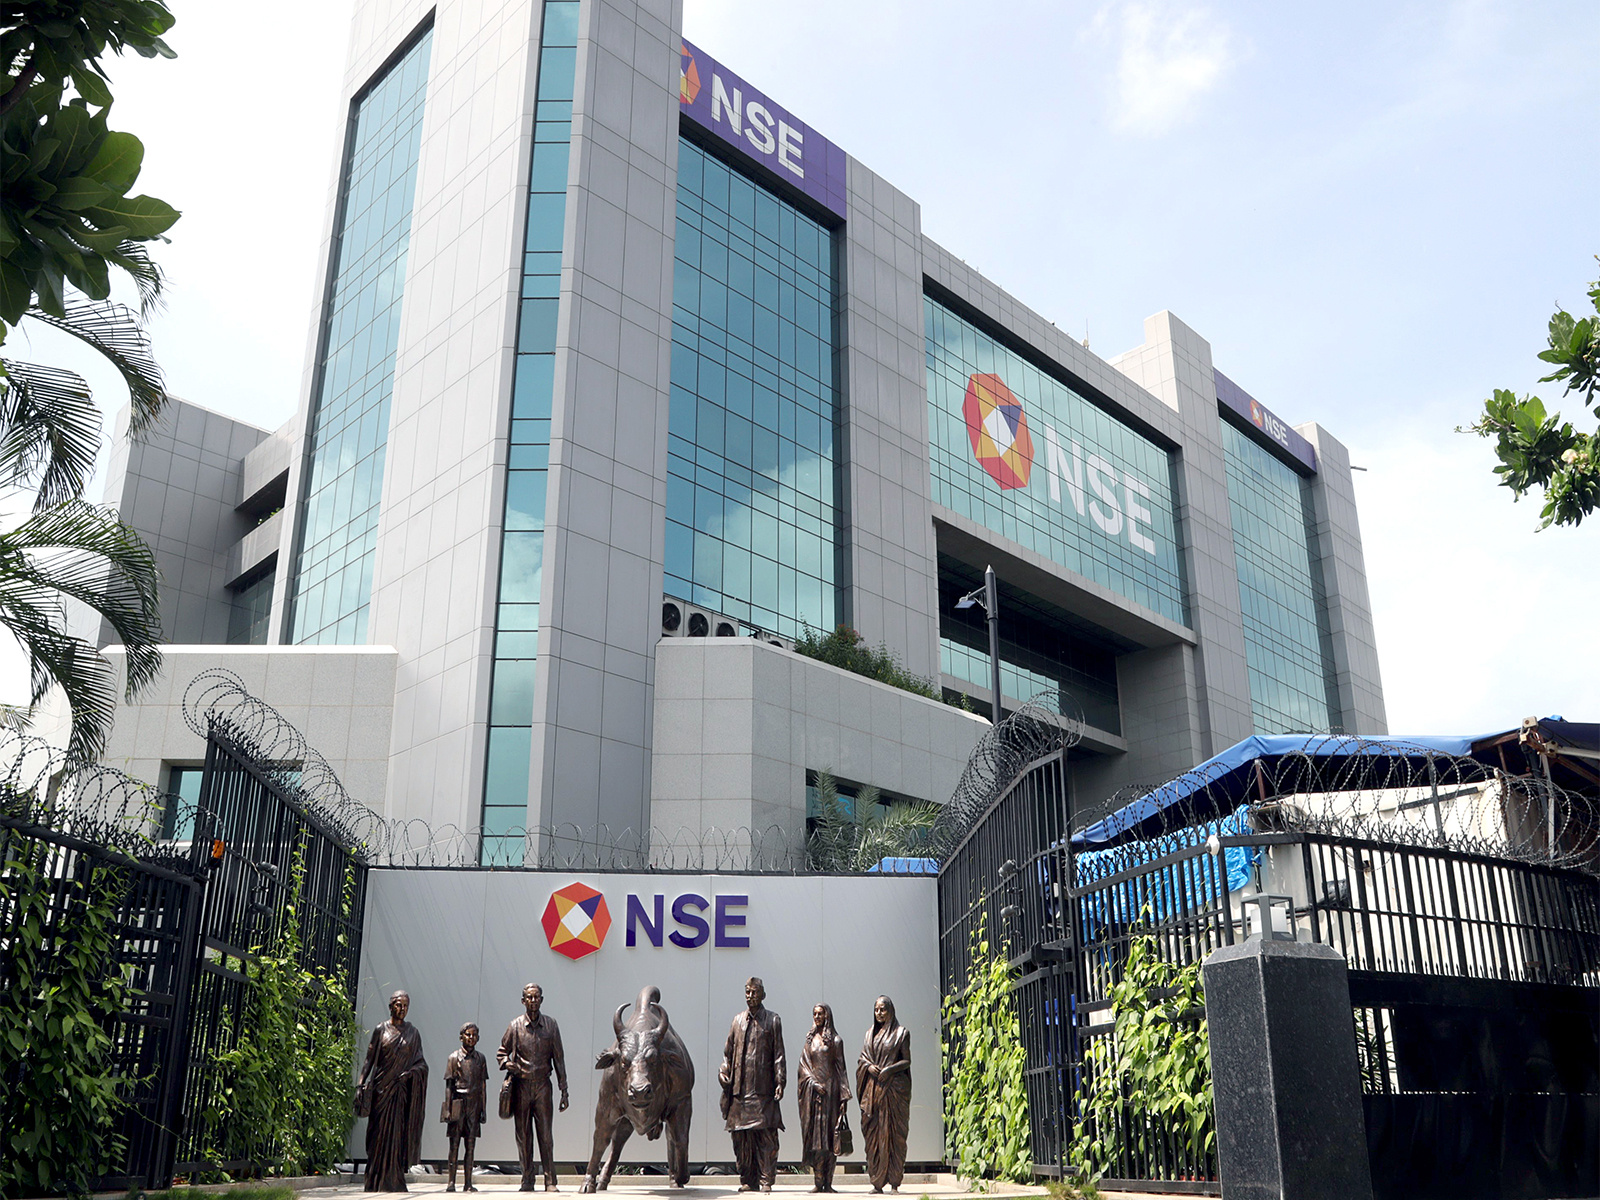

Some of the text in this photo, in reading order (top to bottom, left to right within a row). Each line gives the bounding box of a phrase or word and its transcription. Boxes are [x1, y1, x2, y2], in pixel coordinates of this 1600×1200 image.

[711, 73, 804, 179] NSE
[1264, 412, 1288, 446] NSE
[1046, 423, 1156, 556] NSE
[625, 893, 750, 949] NSE
